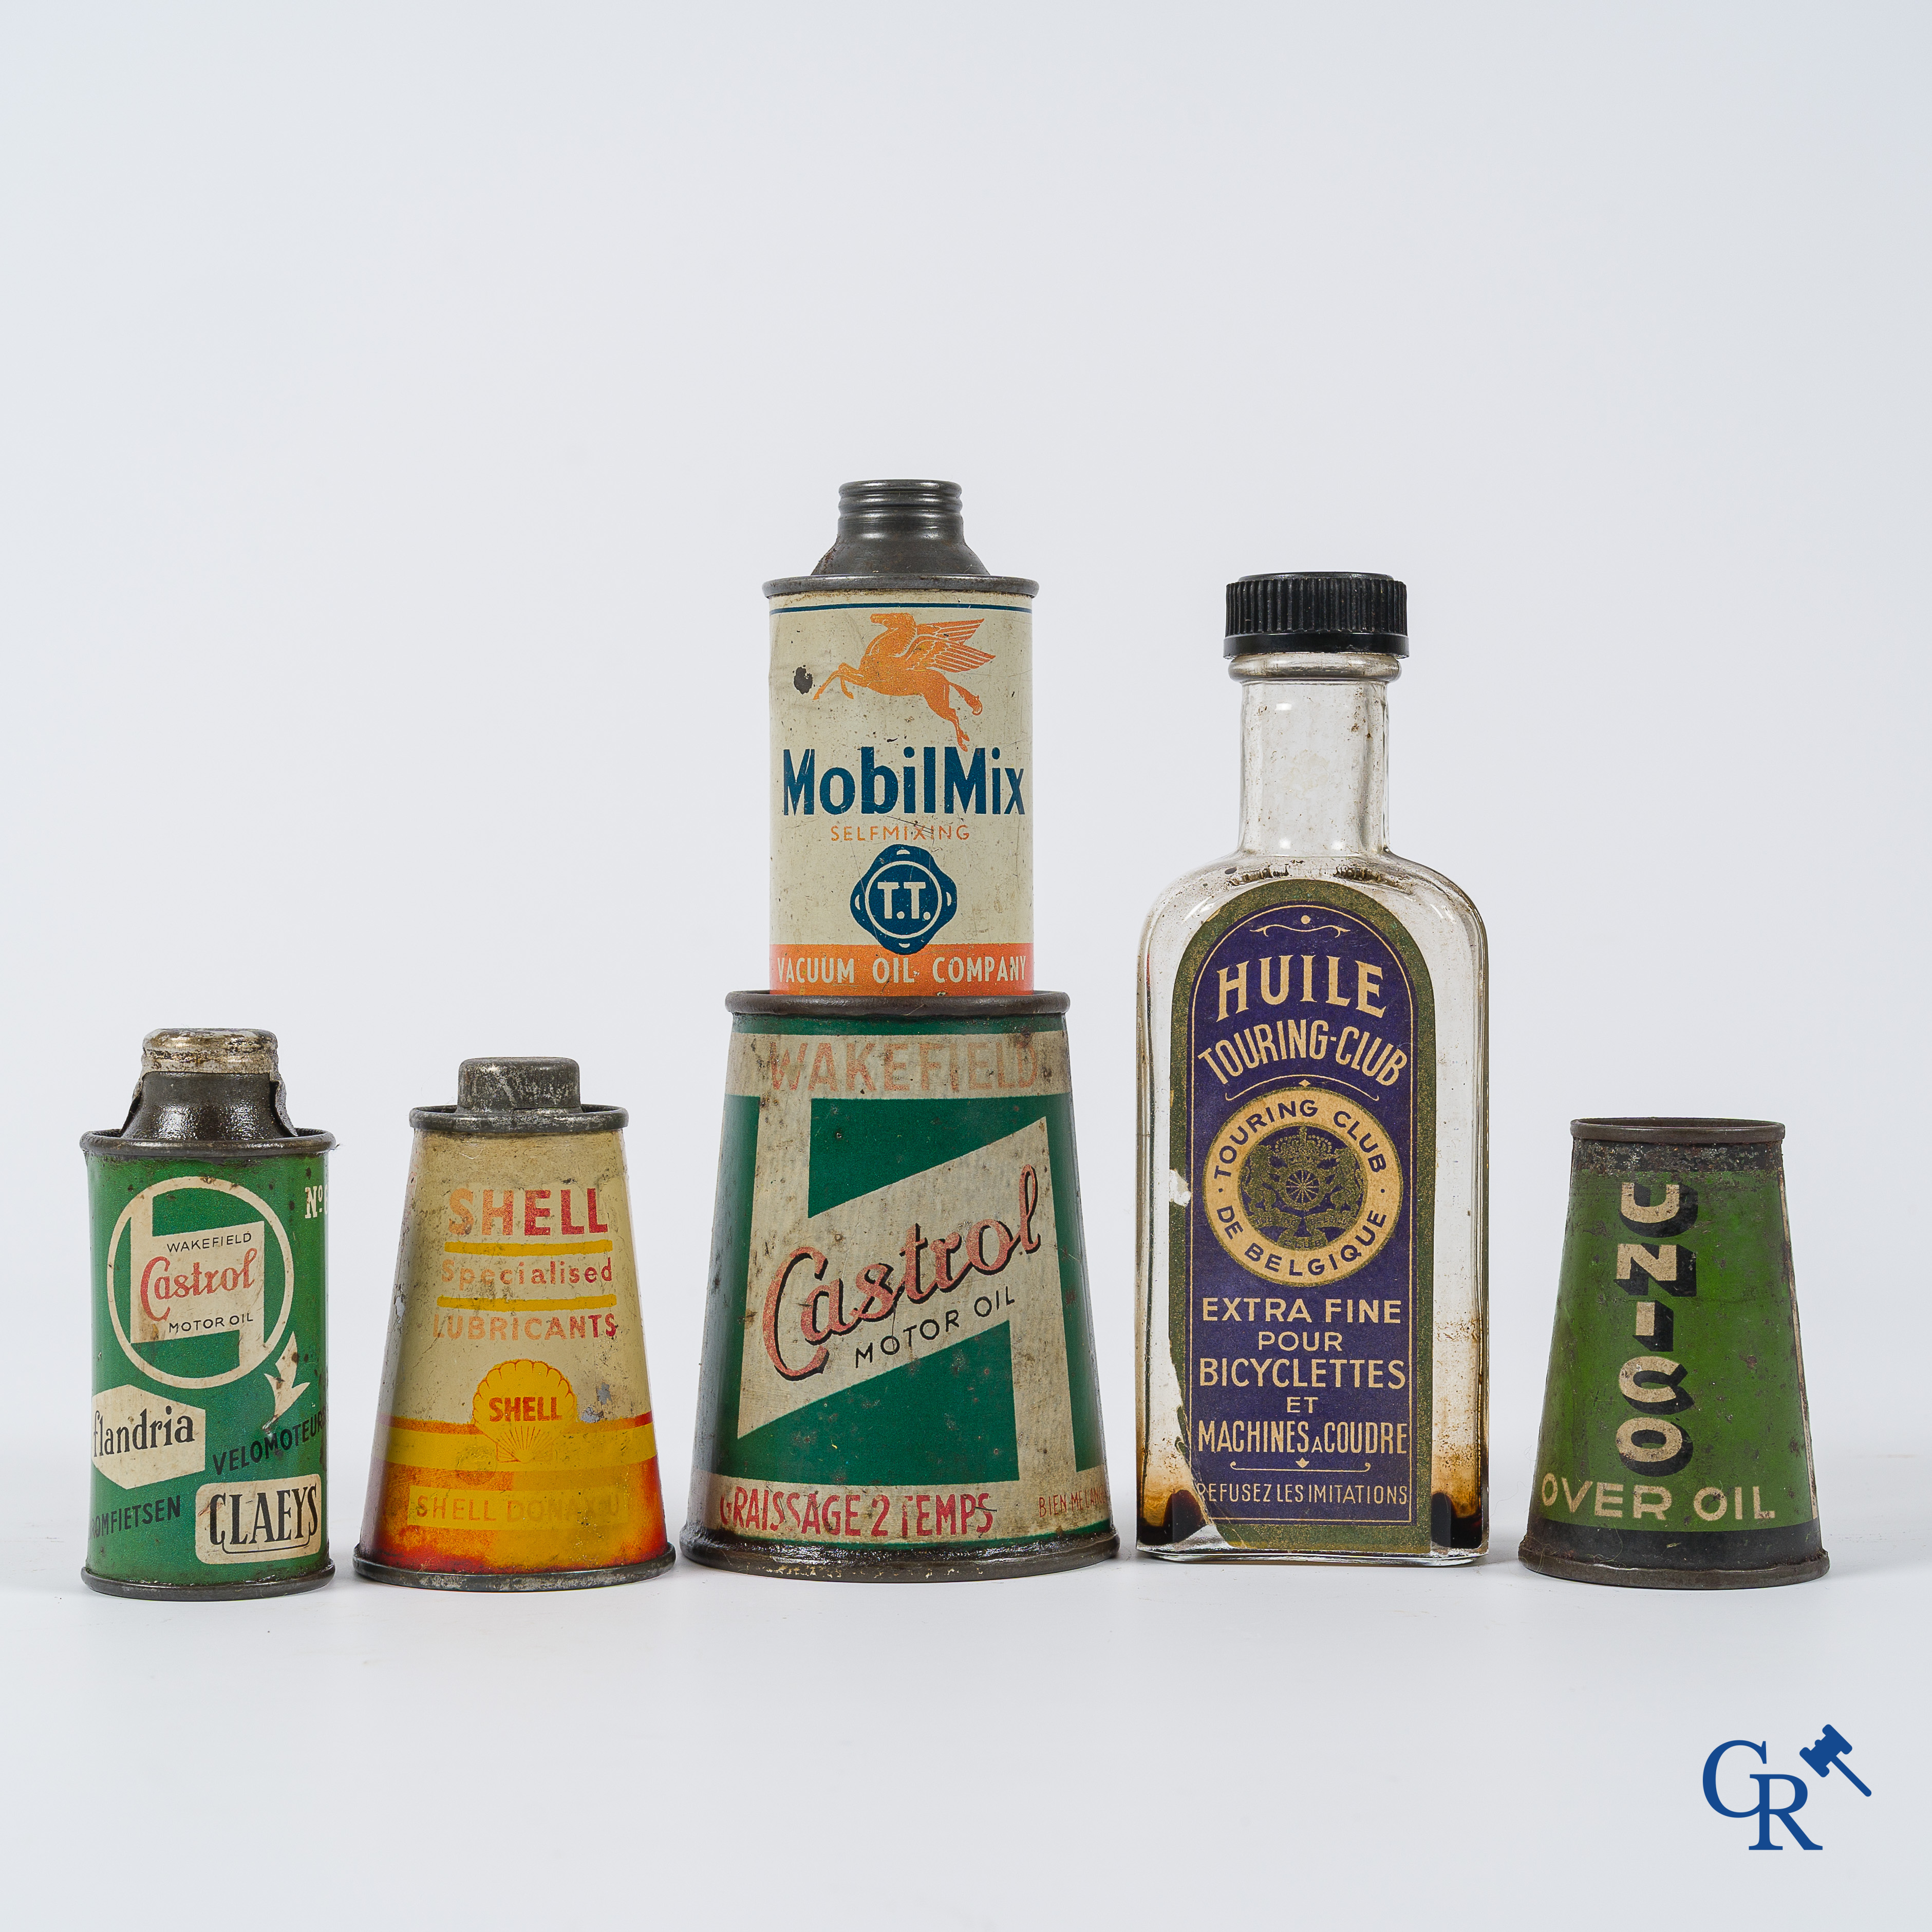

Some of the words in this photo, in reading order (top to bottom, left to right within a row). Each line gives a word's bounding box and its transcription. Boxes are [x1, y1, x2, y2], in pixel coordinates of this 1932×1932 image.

[783, 746, 1025, 816] MobilMix
[831, 825, 970, 841] SELFMIXING
[877, 881, 931, 920] T.T.
[778, 958, 854, 983] VACUUM
[873, 958, 915, 983] OIL
[933, 955, 1026, 983] COMPANY
[1216, 954, 1386, 1023] HUILE
[771, 1042, 1039, 1092] WAKEFIELD
[1197, 1019, 1408, 1086] TOURING-CLUB
[1214, 1099, 1318, 1179] TOURING
[1333, 1110, 1387, 1173] CLUB
[448, 1188, 608, 1236] SHELL
[166, 1232, 252, 1253] WAKEFIELD
[1216, 1205, 1244, 1240] DE
[1244, 1210, 1387, 1277] BELGIQUE
[140, 1248, 258, 1322] Castrol
[441, 1256, 613, 1291] Specialised
[762, 1165, 1041, 1382] Castrol
[168, 1317, 225, 1334] MOTOR
[230, 1312, 254, 1326] OIL
[433, 1313, 618, 1341] LUBRICANTS
[855, 1309, 960, 1368] MOTOR
[974, 1286, 1015, 1318] OIL
[1203, 1298, 1312, 1323] EXTRA
[1325, 1299, 1401, 1324] FINE
[1614, 1181, 1698, 1477] UNICO
[1259, 1331, 1343, 1352] POUR
[1200, 1358, 1406, 1390] BICYCLETTES
[489, 1396, 562, 1423] SHELL
[1287, 1397, 1319, 1414] ET
[93, 1405, 195, 1458] flandria
[1198, 1420, 1309, 1453] MACHINES
[1324, 1421, 1408, 1454] COUDRE
[209, 1482, 318, 1546] CLAEYS
[416, 1495, 497, 1522] SHELL
[720, 1486, 861, 1536] GRAISSAGE
[871, 1494, 891, 1537] 2
[899, 1493, 993, 1537] TEMPS
[1039, 1494, 1067, 1517] BIEN
[1277, 1484, 1304, 1503] LES
[1308, 1485, 1408, 1505] IMITATIONS
[1542, 1472, 1672, 1521] OVER
[1694, 1486, 1775, 1521] OIL
